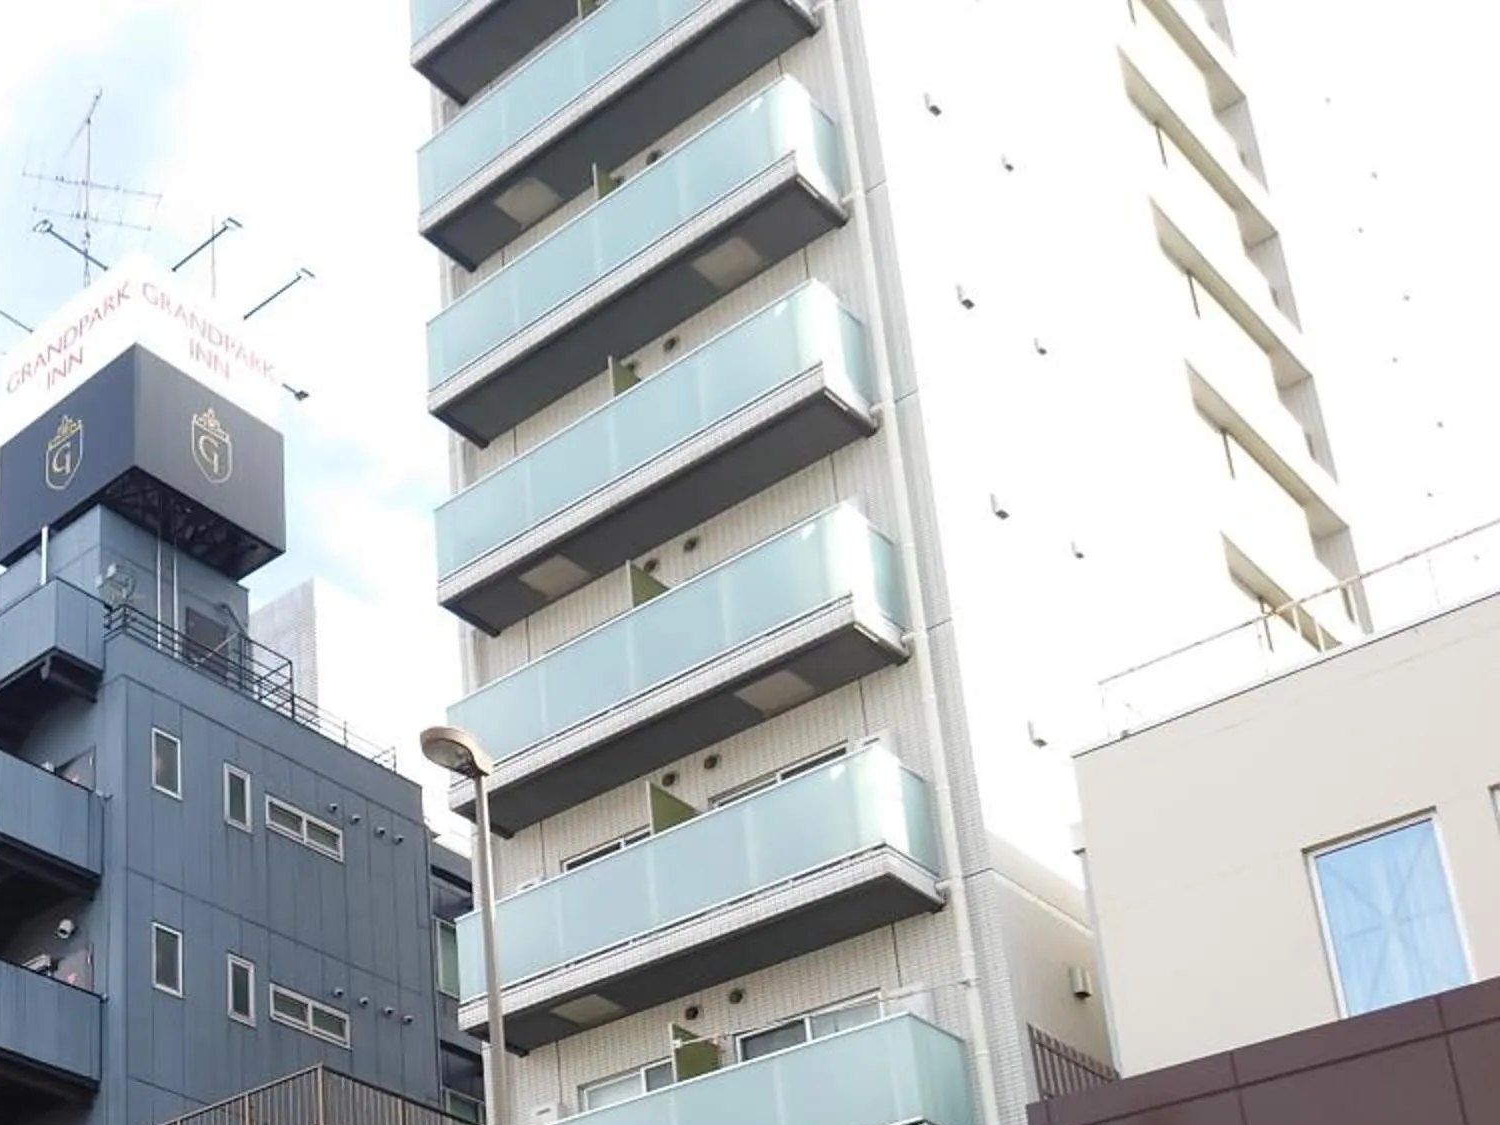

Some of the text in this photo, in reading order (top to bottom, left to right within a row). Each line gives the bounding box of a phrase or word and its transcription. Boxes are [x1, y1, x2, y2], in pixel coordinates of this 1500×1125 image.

[6, 281, 131, 394] GRANDPARK
[142, 281, 276, 381] GRANDPARK
[189, 338, 231, 380] INN
[46, 346, 84, 390] INN
